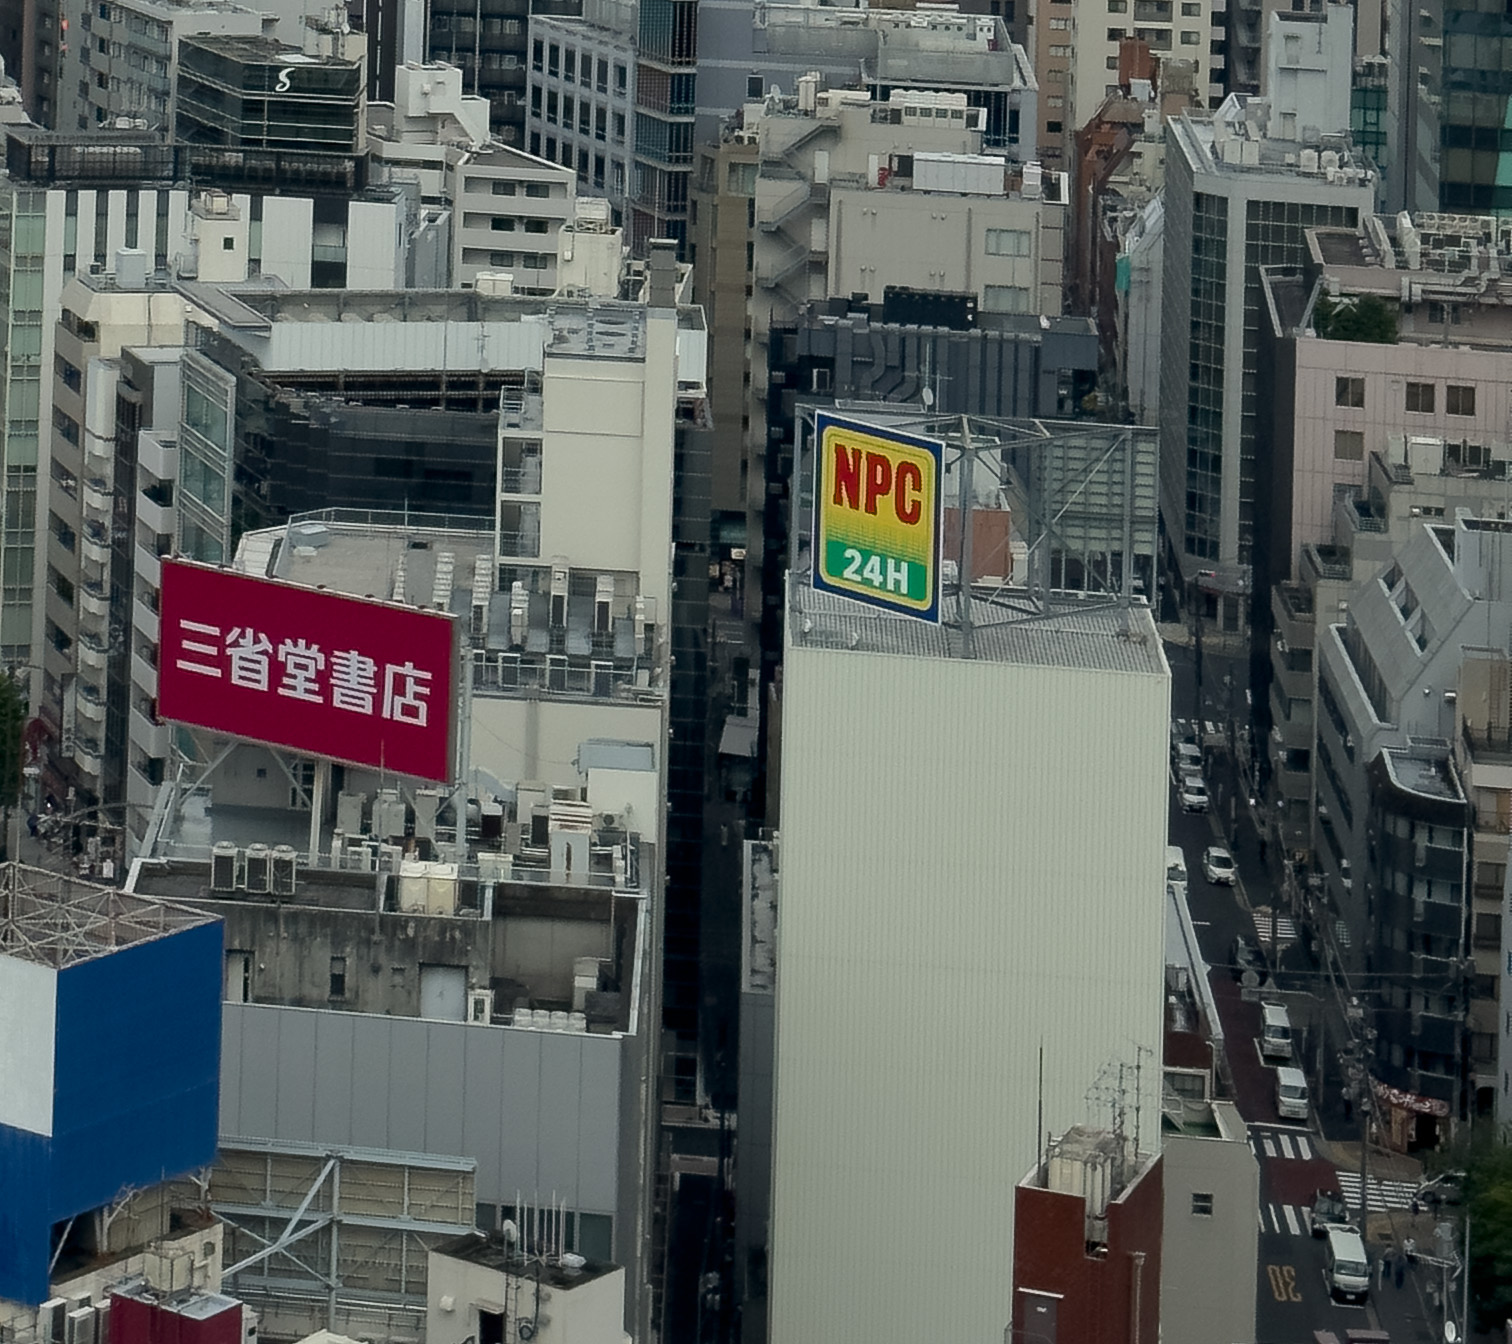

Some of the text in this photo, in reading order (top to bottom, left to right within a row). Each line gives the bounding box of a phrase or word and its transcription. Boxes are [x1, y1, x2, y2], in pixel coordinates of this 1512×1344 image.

[833, 442, 923, 526] NPC
[842, 548, 909, 595] 24H
[176, 618, 433, 728] 三省堂書店
